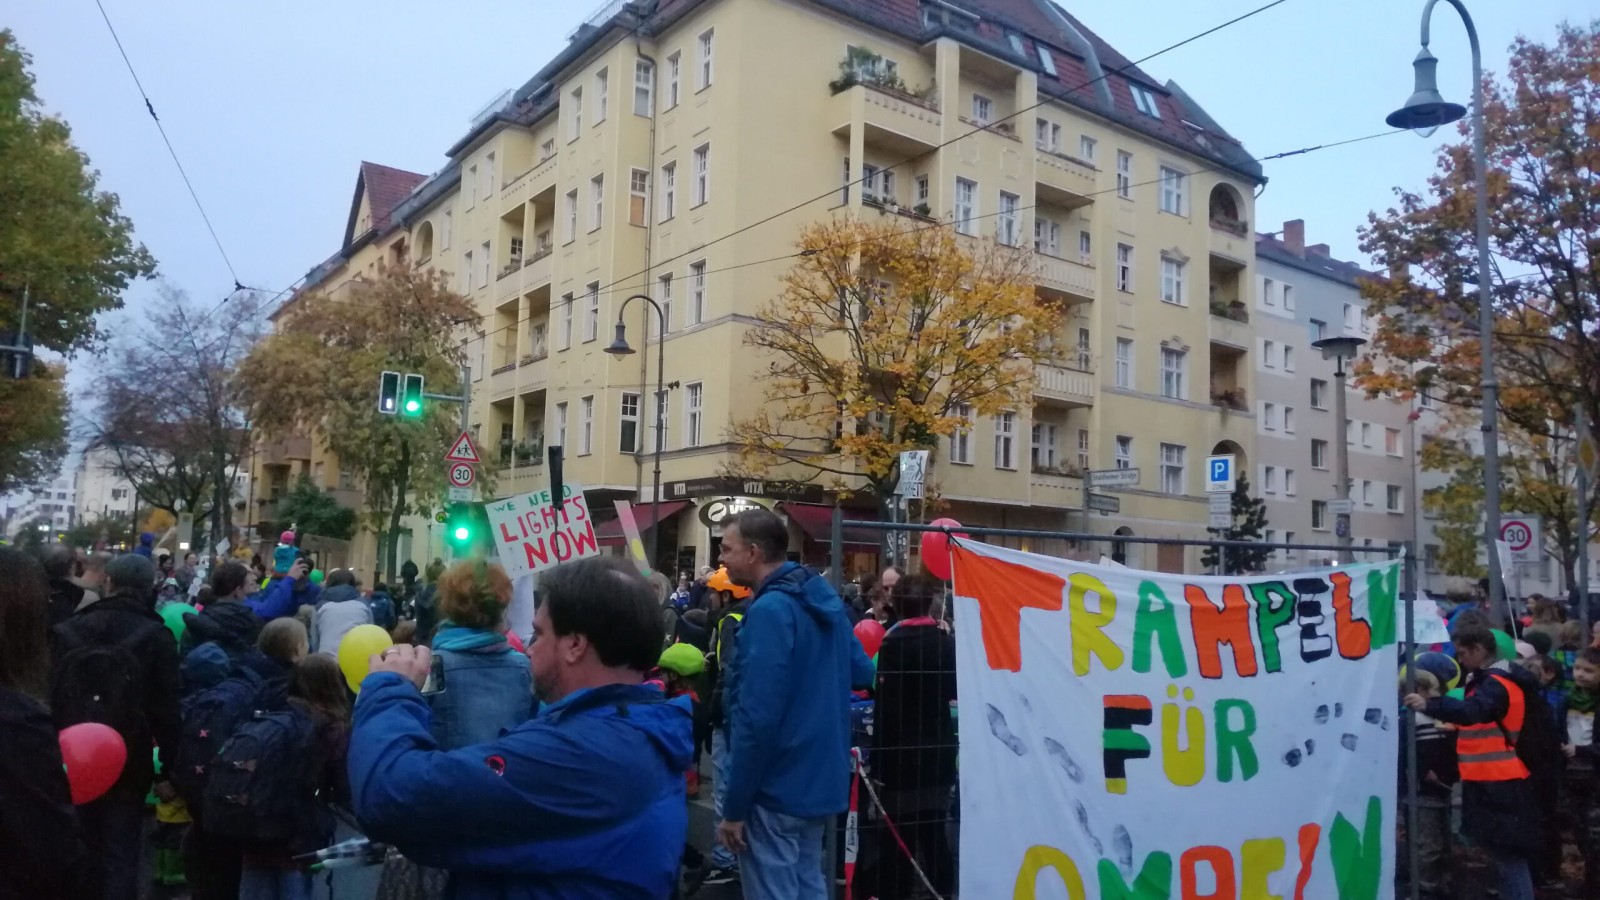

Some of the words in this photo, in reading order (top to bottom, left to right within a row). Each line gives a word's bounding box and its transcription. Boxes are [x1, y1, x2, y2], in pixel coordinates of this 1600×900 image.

[455, 468, 470, 481] 30
[1214, 462, 1225, 479] P
[673, 482, 686, 496] VITA
[743, 481, 764, 495] VITA
[494, 501, 516, 512] WE
[528, 484, 572, 507] NED
[500, 495, 586, 544] LIGHTS
[1507, 528, 1526, 543] 30
[523, 520, 597, 570] NOW
[1511, 552, 1528, 561] ONE
[952, 544, 1399, 680] TRAMPELN
[1102, 683, 1260, 796] FÜR
